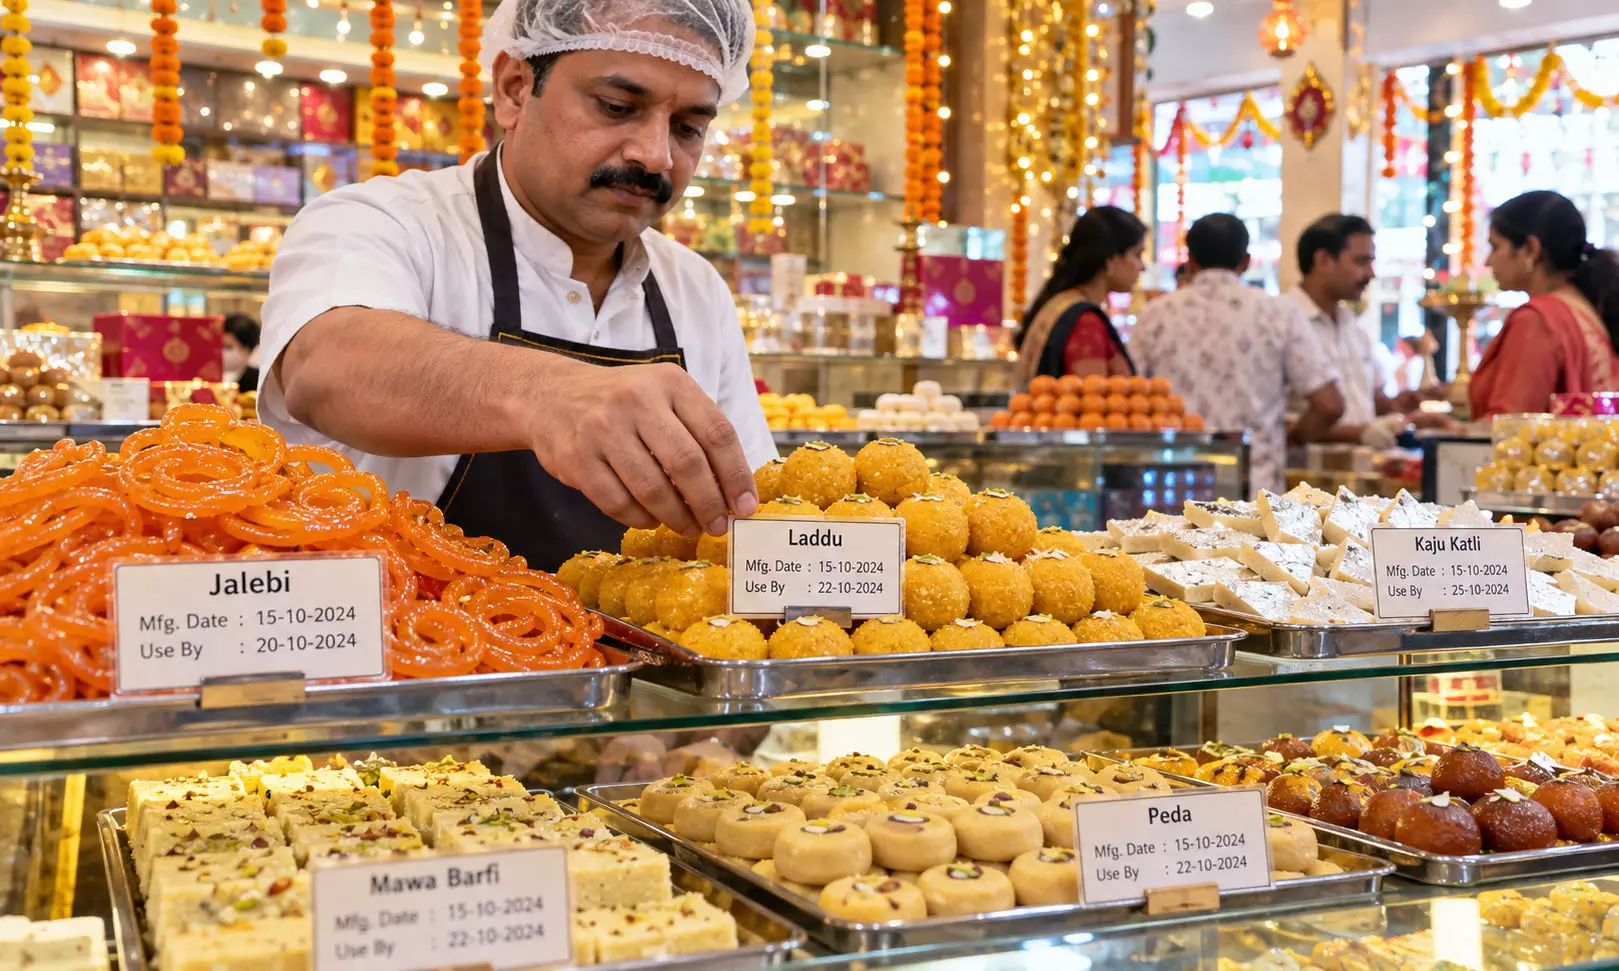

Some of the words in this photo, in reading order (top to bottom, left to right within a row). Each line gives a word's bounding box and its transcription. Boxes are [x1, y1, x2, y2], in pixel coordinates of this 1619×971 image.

[789, 529, 842, 546] Laddu
[1416, 536, 1445, 555] Kaju
[1450, 536, 1480, 551] Katli
[746, 559, 771, 575] Mfg.
[776, 560, 801, 572] Date
[819, 561, 883, 573] 15-10-2024
[1387, 565, 1409, 579] Mfg.
[1412, 565, 1435, 576] Date
[1451, 565, 1507, 576] 15-10-2024
[209, 570, 289, 595] Jalebi
[746, 581, 767, 592] Use
[771, 581, 785, 596] By
[818, 582, 883, 593] 22-10-2024
[1388, 586, 1406, 596] Use
[1410, 585, 1422, 599] By
[1452, 584, 1509, 595] 25-10-2024
[140, 615, 179, 634] Mfg.
[187, 613, 228, 628] Date
[257, 606, 355, 625] 15-10-2024
[141, 643, 174, 659] Use
[181, 642, 202, 660] By
[257, 633, 356, 652] 20-10-2024
[1149, 805, 1192, 824] Peda
[1095, 844, 1122, 860] Mfg.
[1127, 843, 1155, 856] Date
[1176, 833, 1245, 851] 15-10-2024
[370, 874, 438, 894] Mawa
[448, 863, 499, 887] Barfi
[1097, 868, 1119, 881] Use
[1124, 866, 1139, 881] By
[1177, 856, 1247, 874] 22-10-2024
[334, 914, 374, 934] Mfg.
[379, 910, 419, 928] Date
[449, 896, 544, 920] 15-10-2024
[335, 944, 368, 960] Use
[373, 940, 395, 957] By
[448, 924, 544, 948] 22-10-2024
